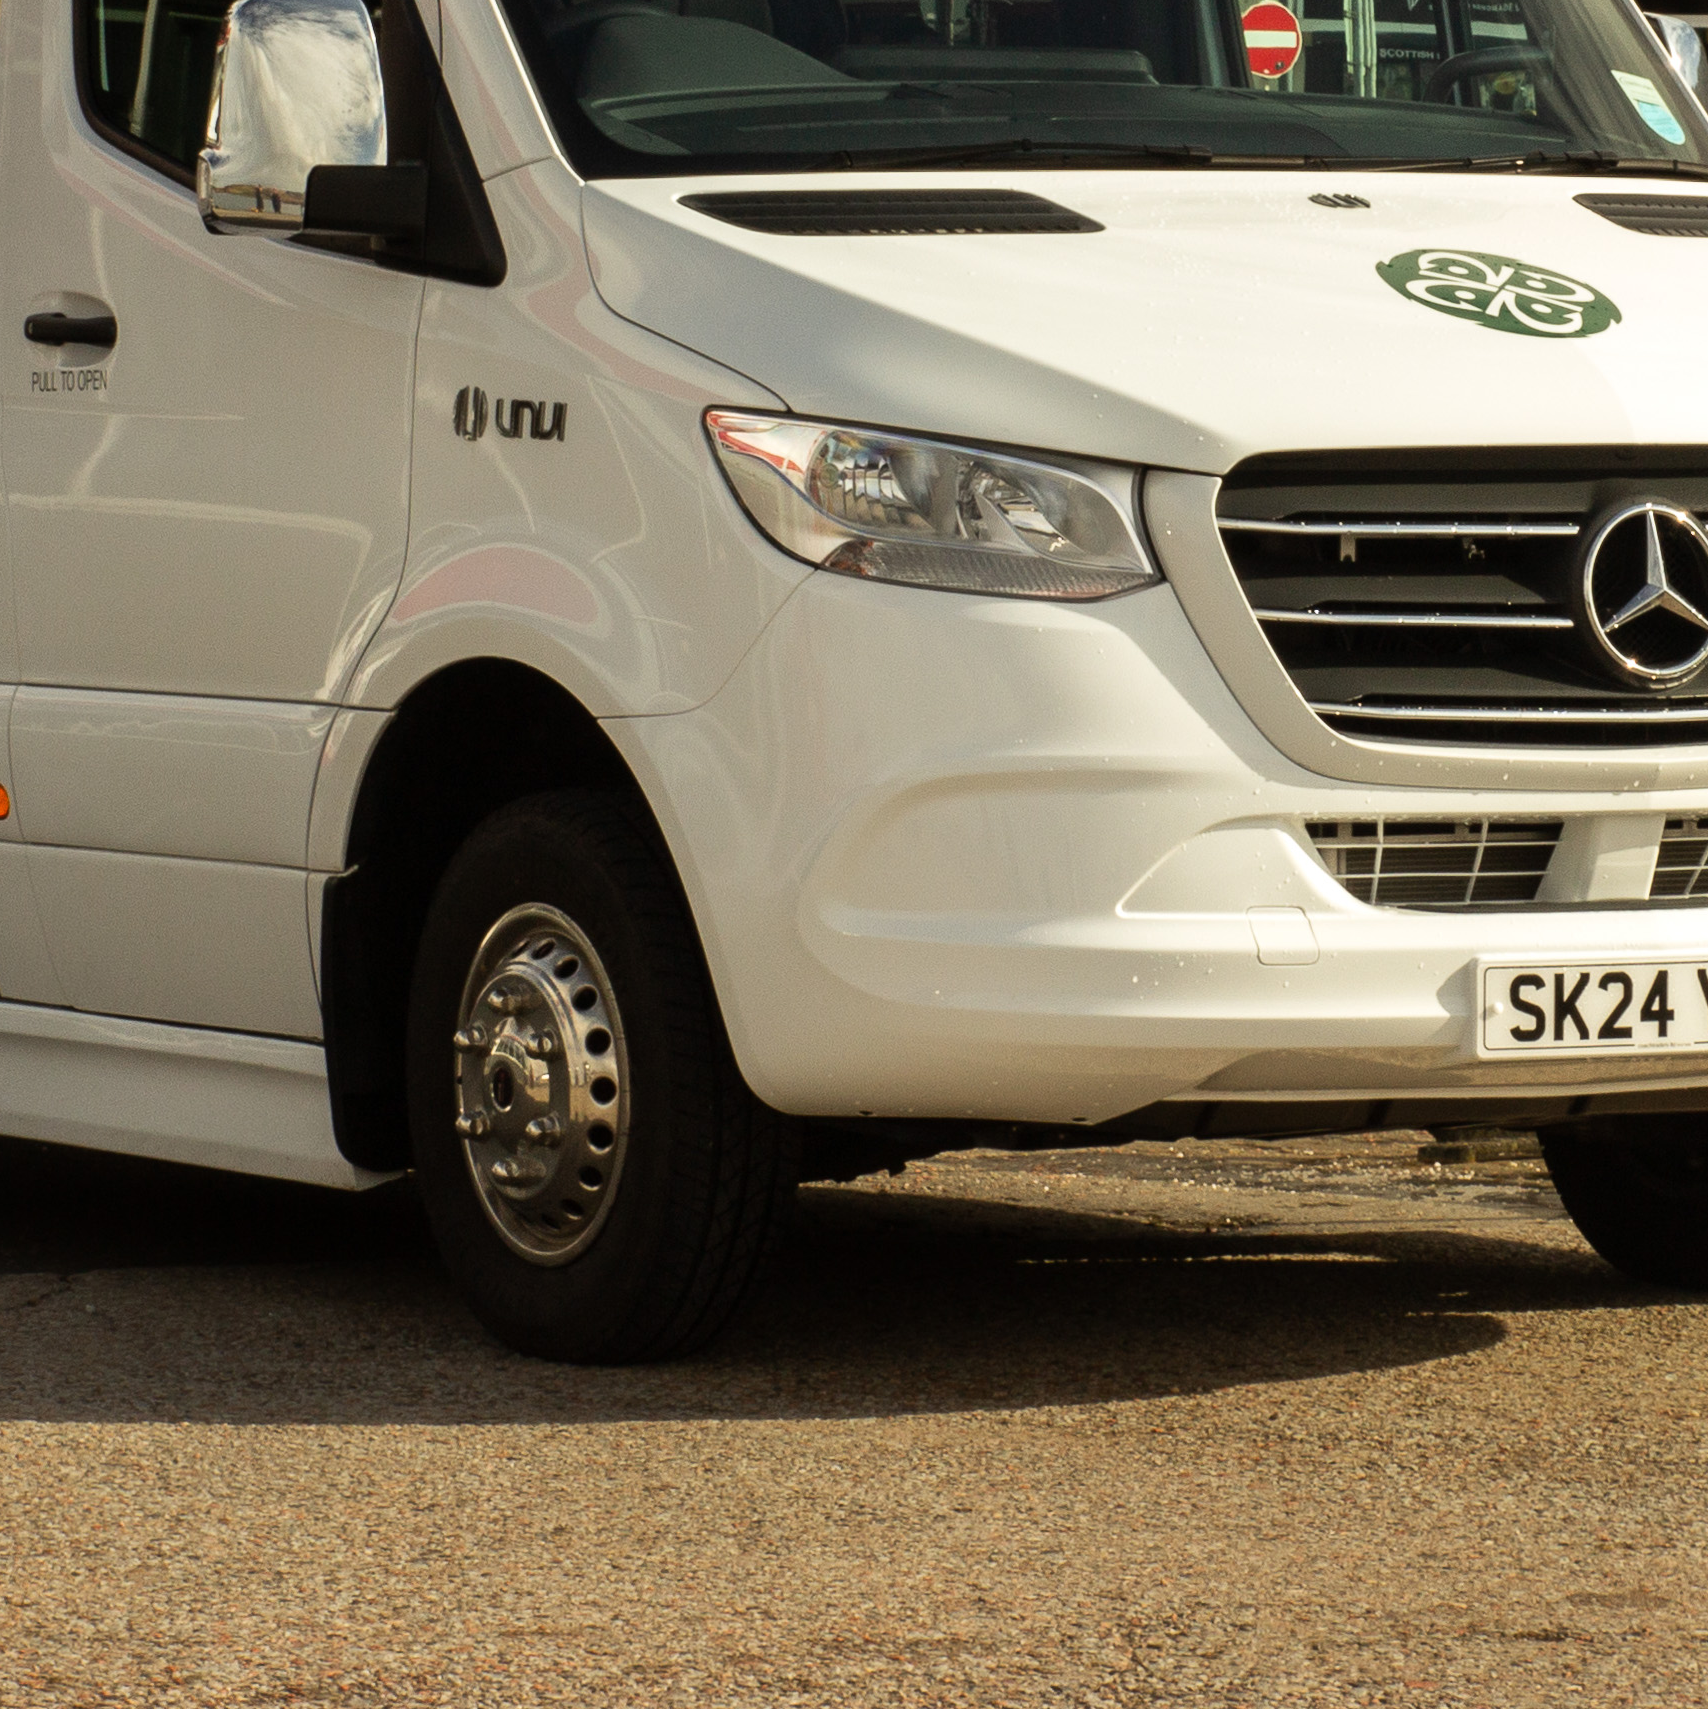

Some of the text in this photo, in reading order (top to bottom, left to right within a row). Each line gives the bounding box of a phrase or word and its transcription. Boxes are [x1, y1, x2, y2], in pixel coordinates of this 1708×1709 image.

[1379, 47, 1434, 60] SCOTTISH
[31, 369, 108, 392] PULL TO OPEN
[1508, 970, 1675, 1042] SK24
